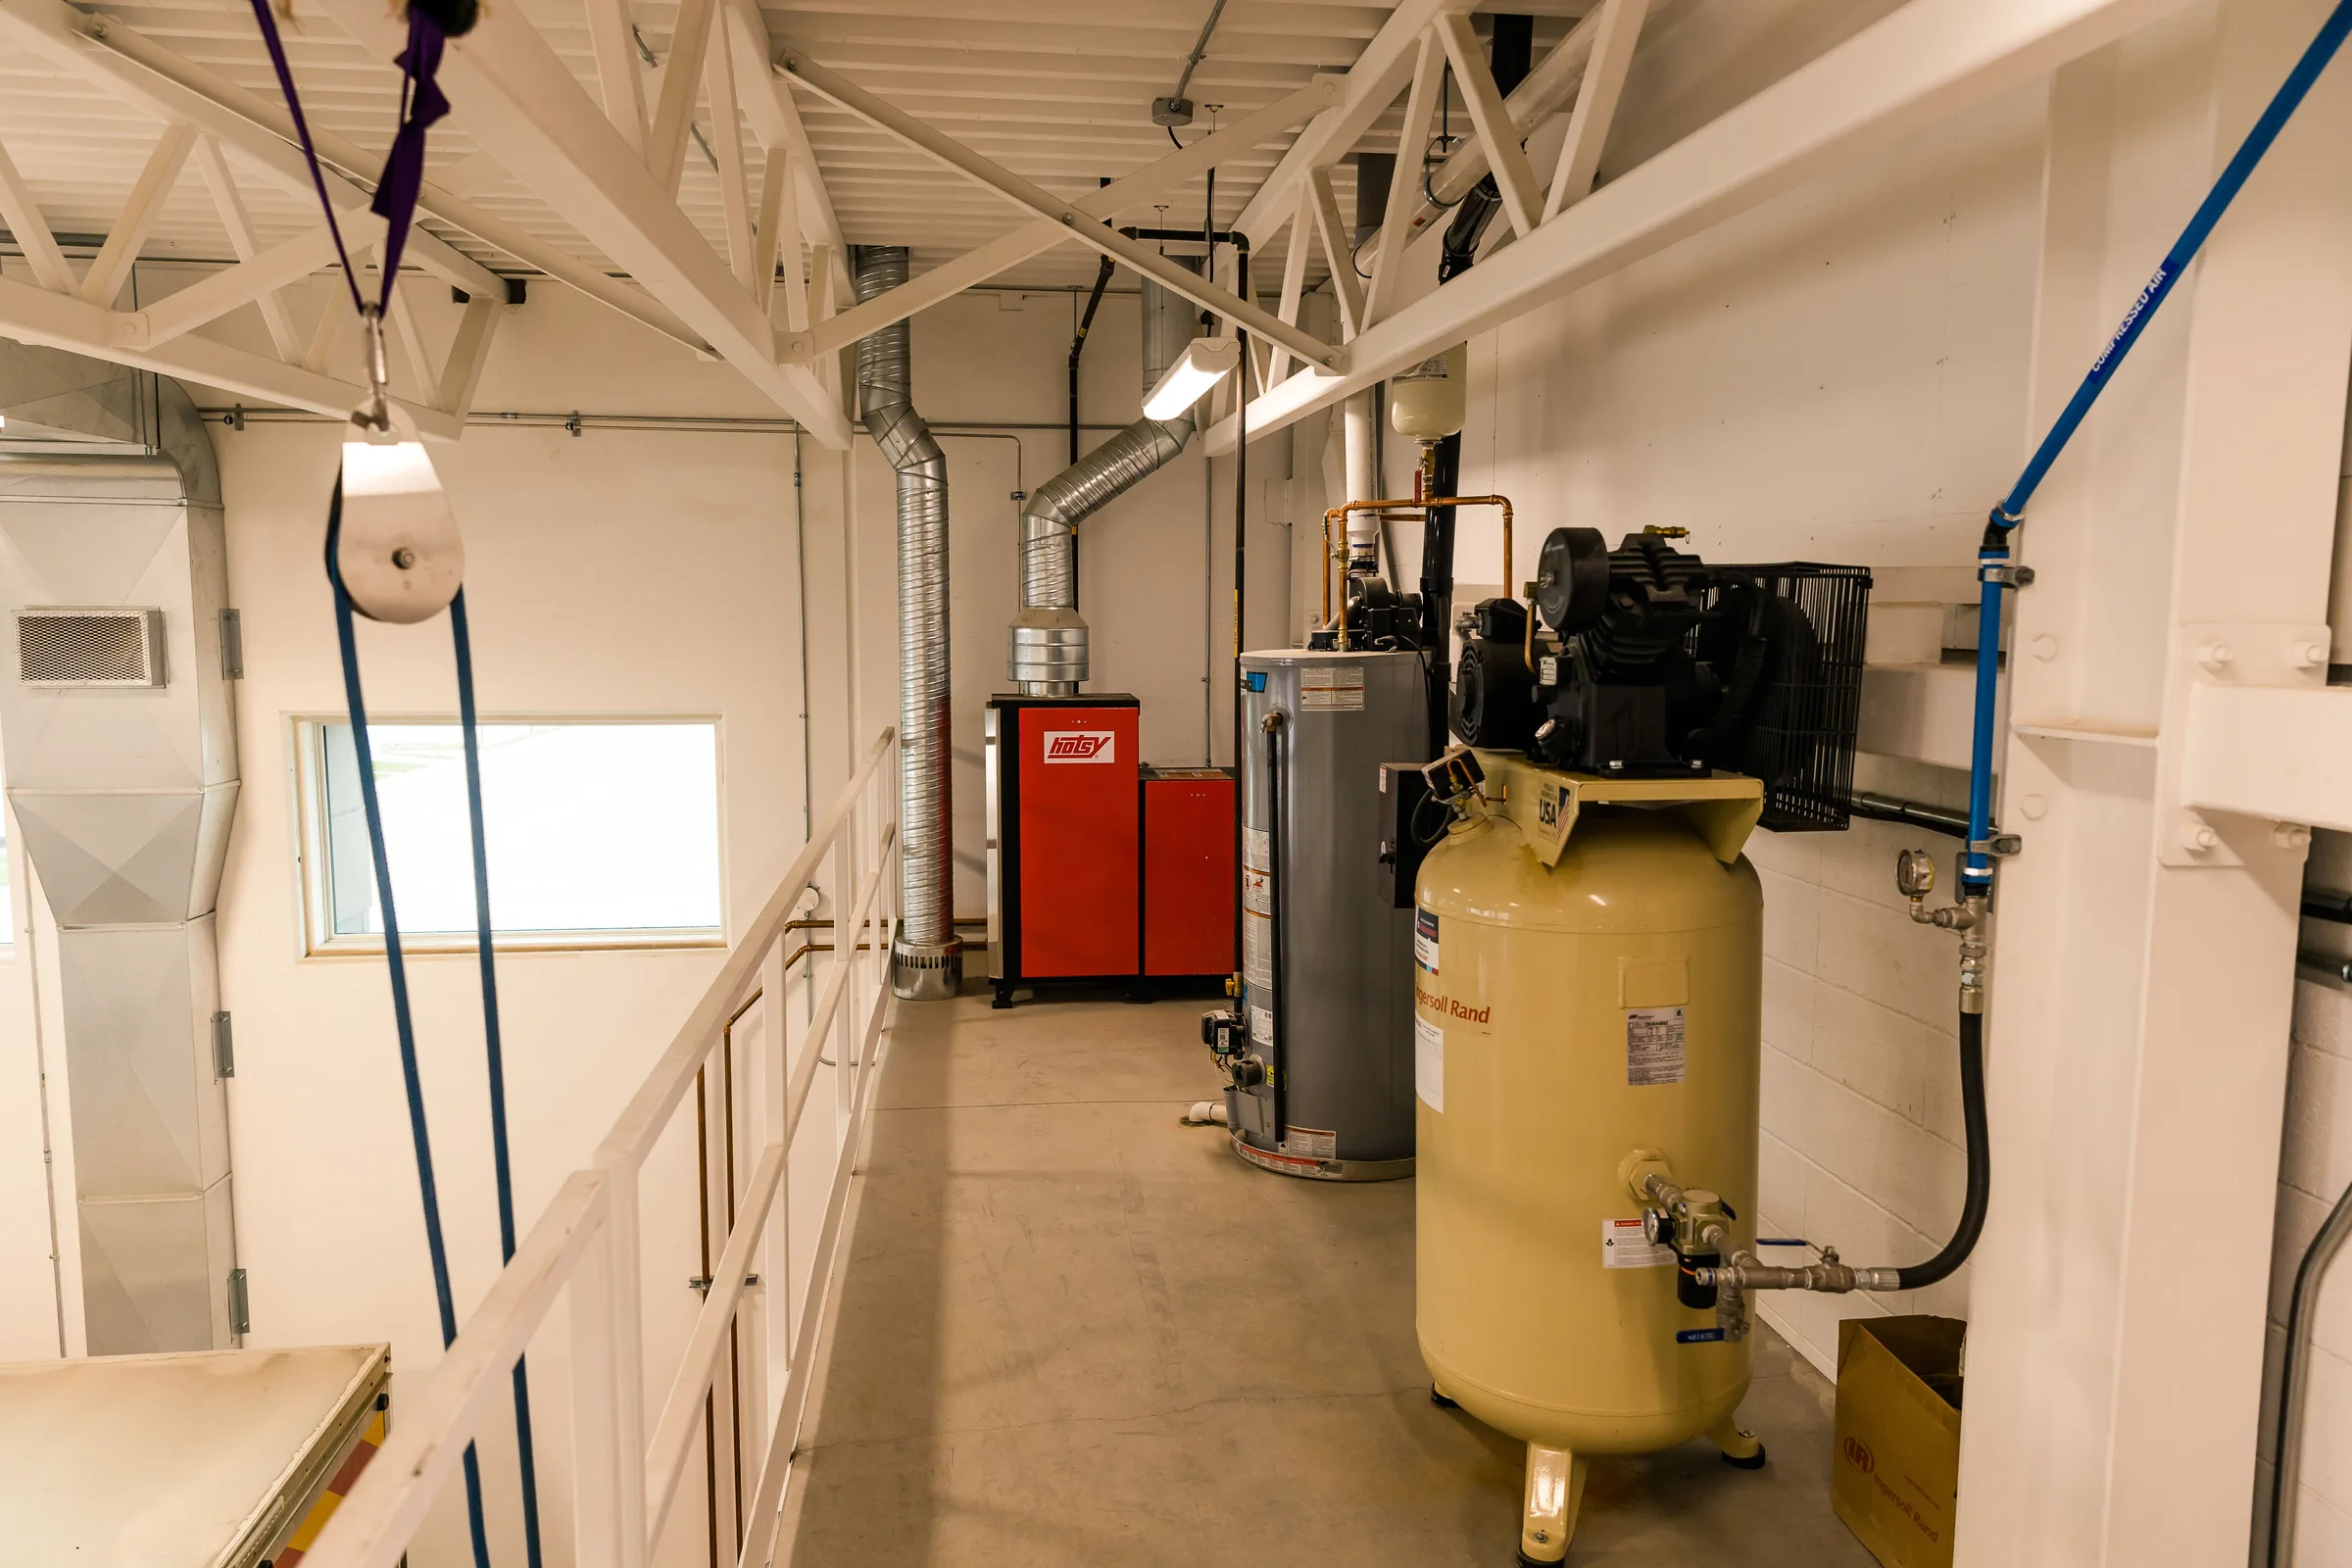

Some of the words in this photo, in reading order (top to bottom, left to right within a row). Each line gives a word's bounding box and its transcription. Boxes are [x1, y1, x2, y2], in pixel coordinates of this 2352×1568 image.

[2092, 292, 2149, 371] COMPRESSED
[2147, 268, 2167, 293] AIR
[1048, 735, 1111, 759] hotsy
[1540, 799, 1556, 828] USA
[1450, 1000, 1492, 1024] Rand
[1874, 1473, 1913, 1518] Ingersoll
[1914, 1511, 1938, 1544] Rand
